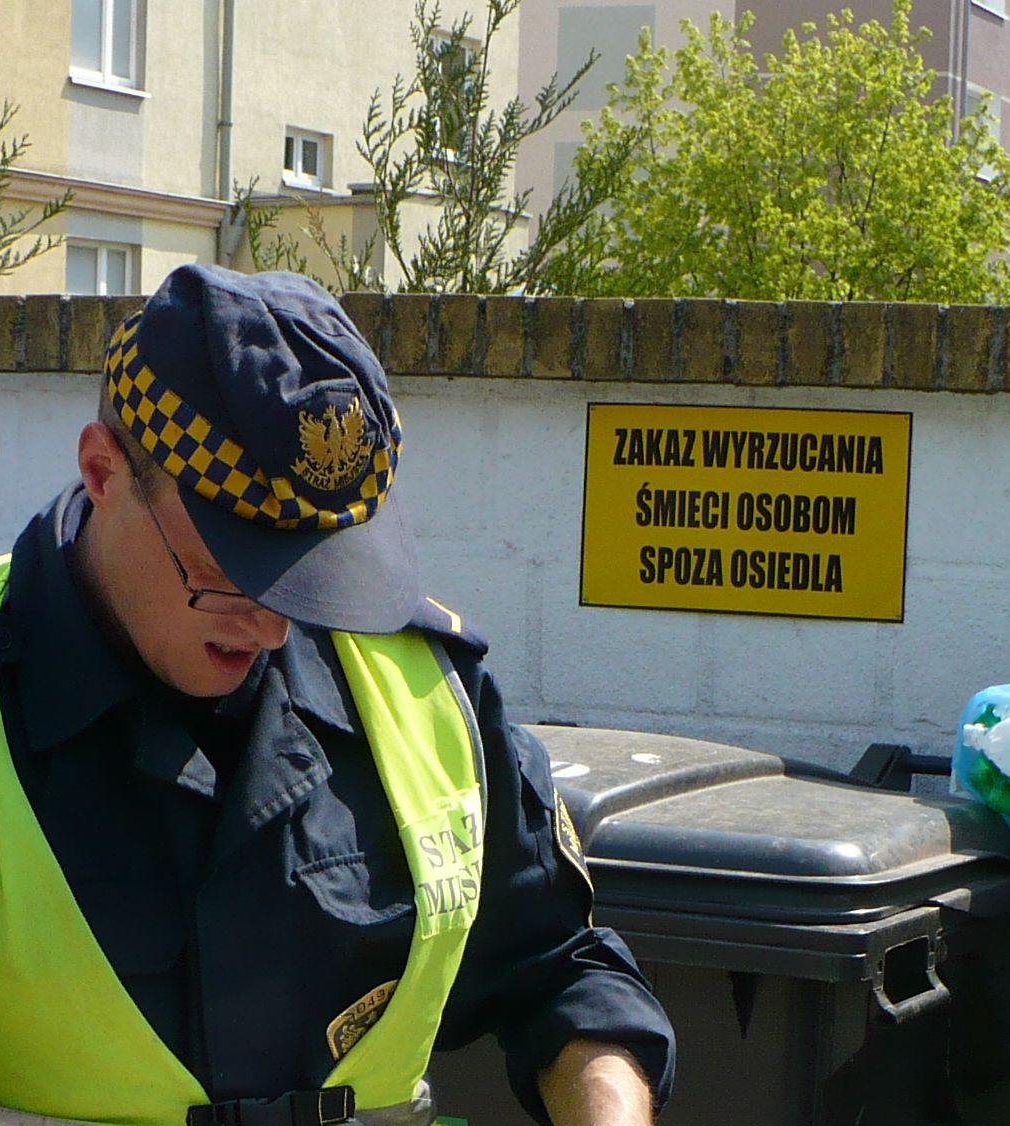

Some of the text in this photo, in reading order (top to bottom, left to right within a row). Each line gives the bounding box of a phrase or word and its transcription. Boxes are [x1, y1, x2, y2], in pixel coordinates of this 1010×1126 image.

[613, 428, 884, 475] ZAKAZ WYRZUCANIA
[635, 482, 856, 535] ŚMIECI OSOBOM
[640, 545, 842, 593] SPOZA OSIEDLA
